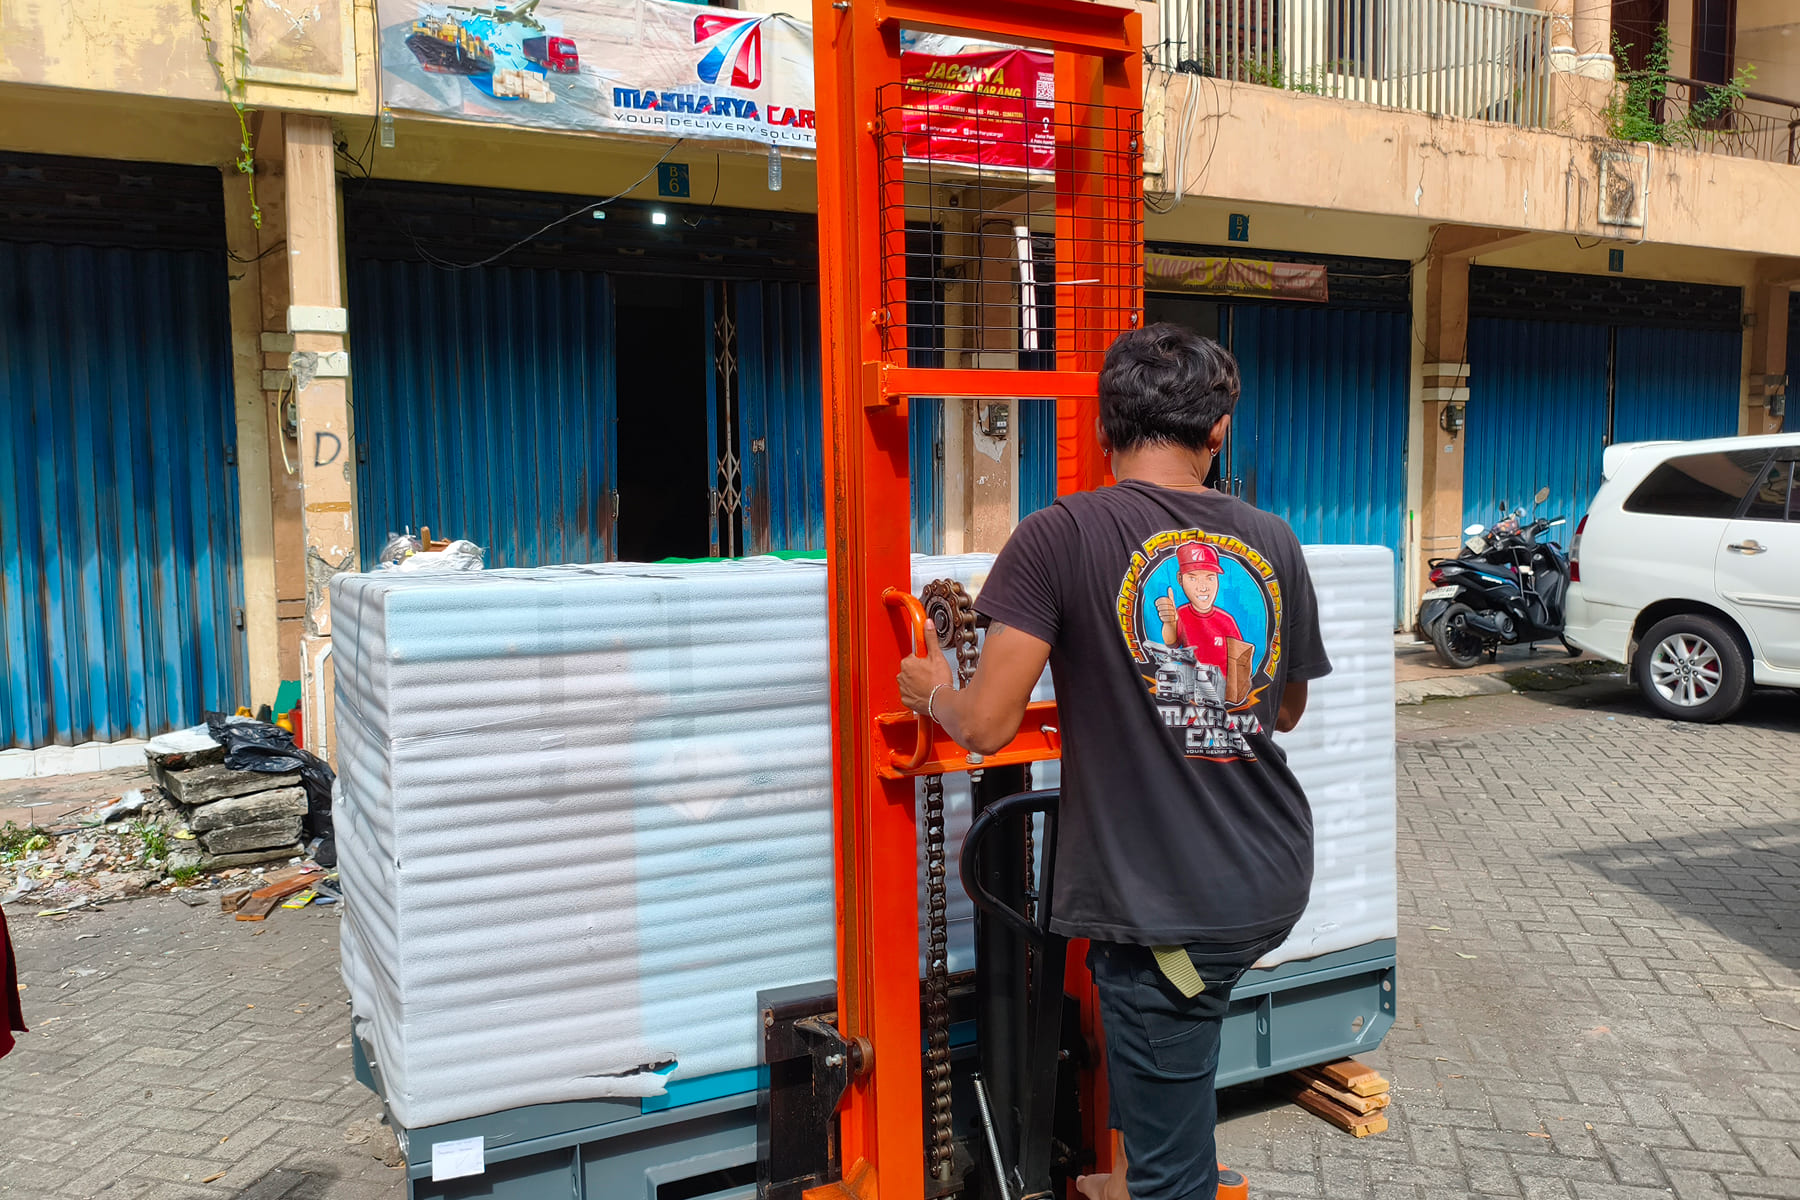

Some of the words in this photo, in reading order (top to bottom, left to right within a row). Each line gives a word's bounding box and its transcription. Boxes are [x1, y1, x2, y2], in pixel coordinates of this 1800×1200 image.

[925, 61, 1005, 84] JAGONYA
[977, 84, 1021, 98] BARANG
[613, 87, 760, 121] MAKHARYA
[767, 104, 816, 129] CAR
[614, 113, 664, 125] YOUR
[670, 118, 756, 133] DELIVERY
[669, 166, 679, 178] B
[669, 178, 680, 193] 6
[1236, 216, 1243, 225] B
[1236, 226, 1243, 239] 7
[314, 432, 342, 468] D
[1117, 551, 1149, 664] JAGONYA
[1143, 528, 1274, 579] PENGIRIMAN
